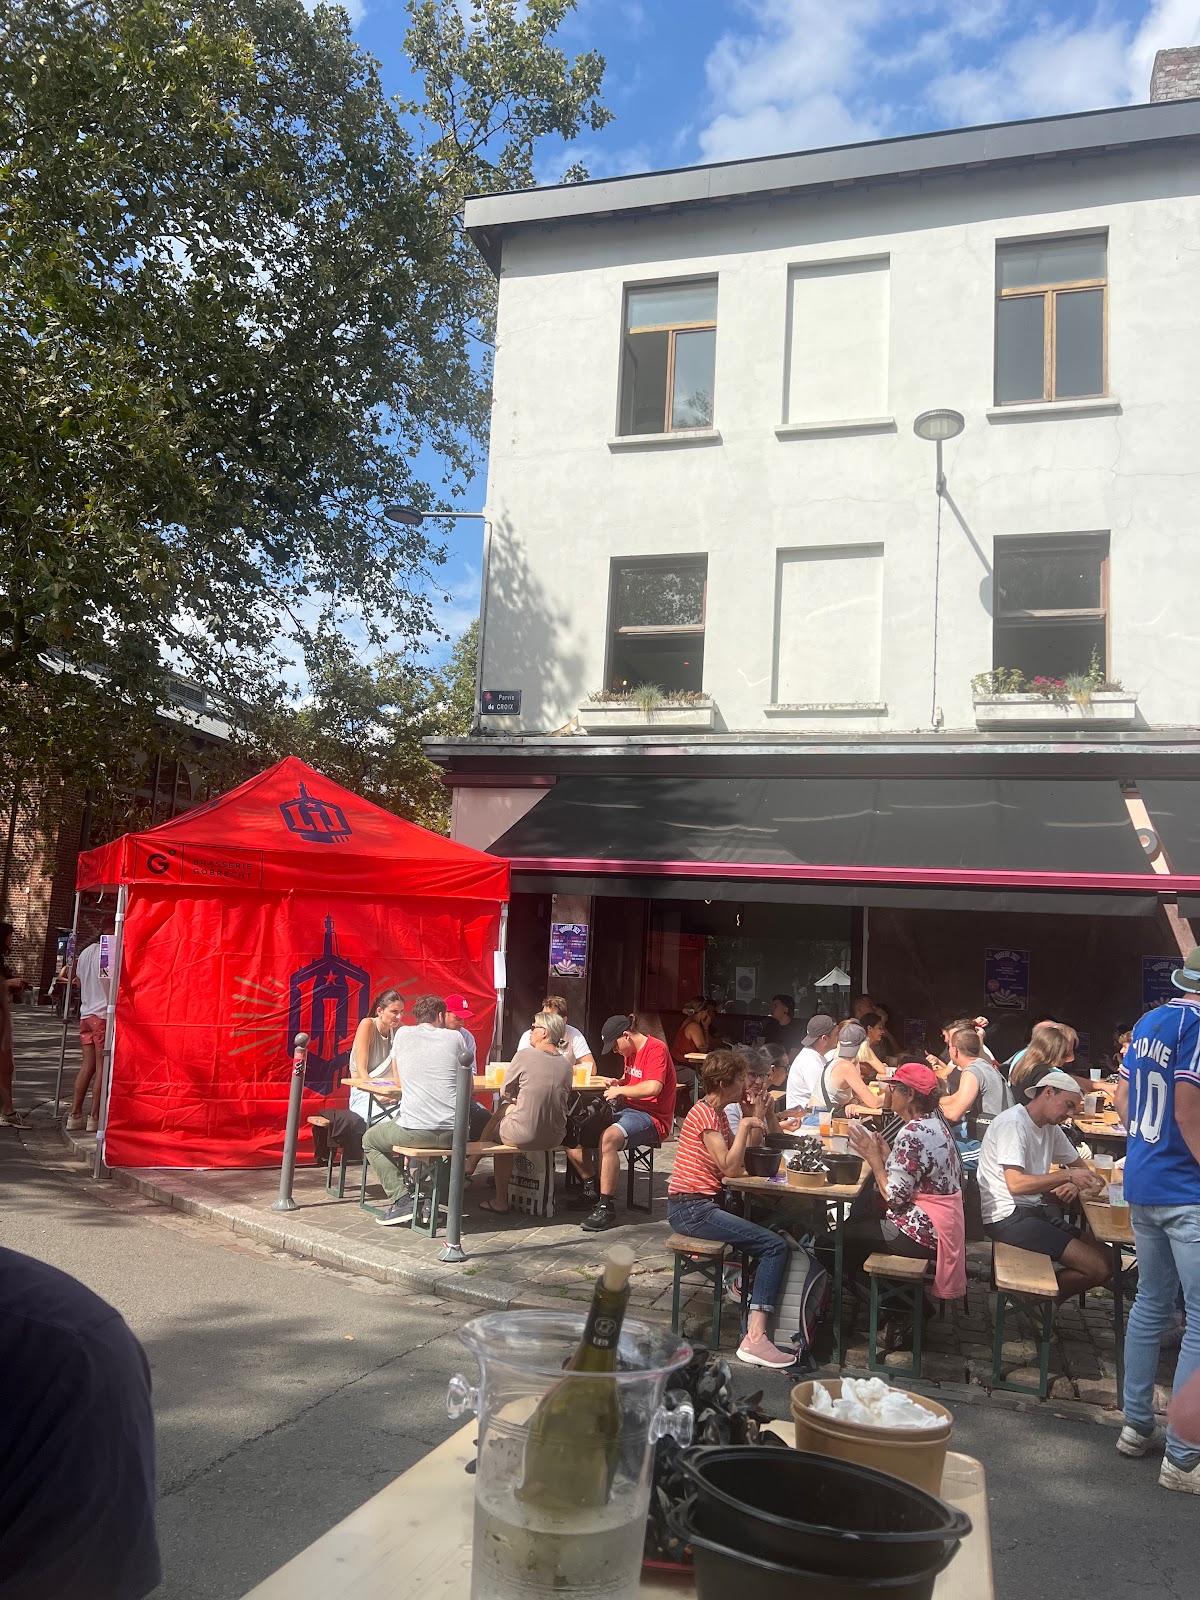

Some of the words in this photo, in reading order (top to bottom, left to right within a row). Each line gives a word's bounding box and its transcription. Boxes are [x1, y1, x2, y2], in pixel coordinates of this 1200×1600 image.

[193, 859, 252, 870] BRASSERIE
[193, 868, 252, 879] GOBRECHT
[1130, 1068, 1168, 1144] 10
